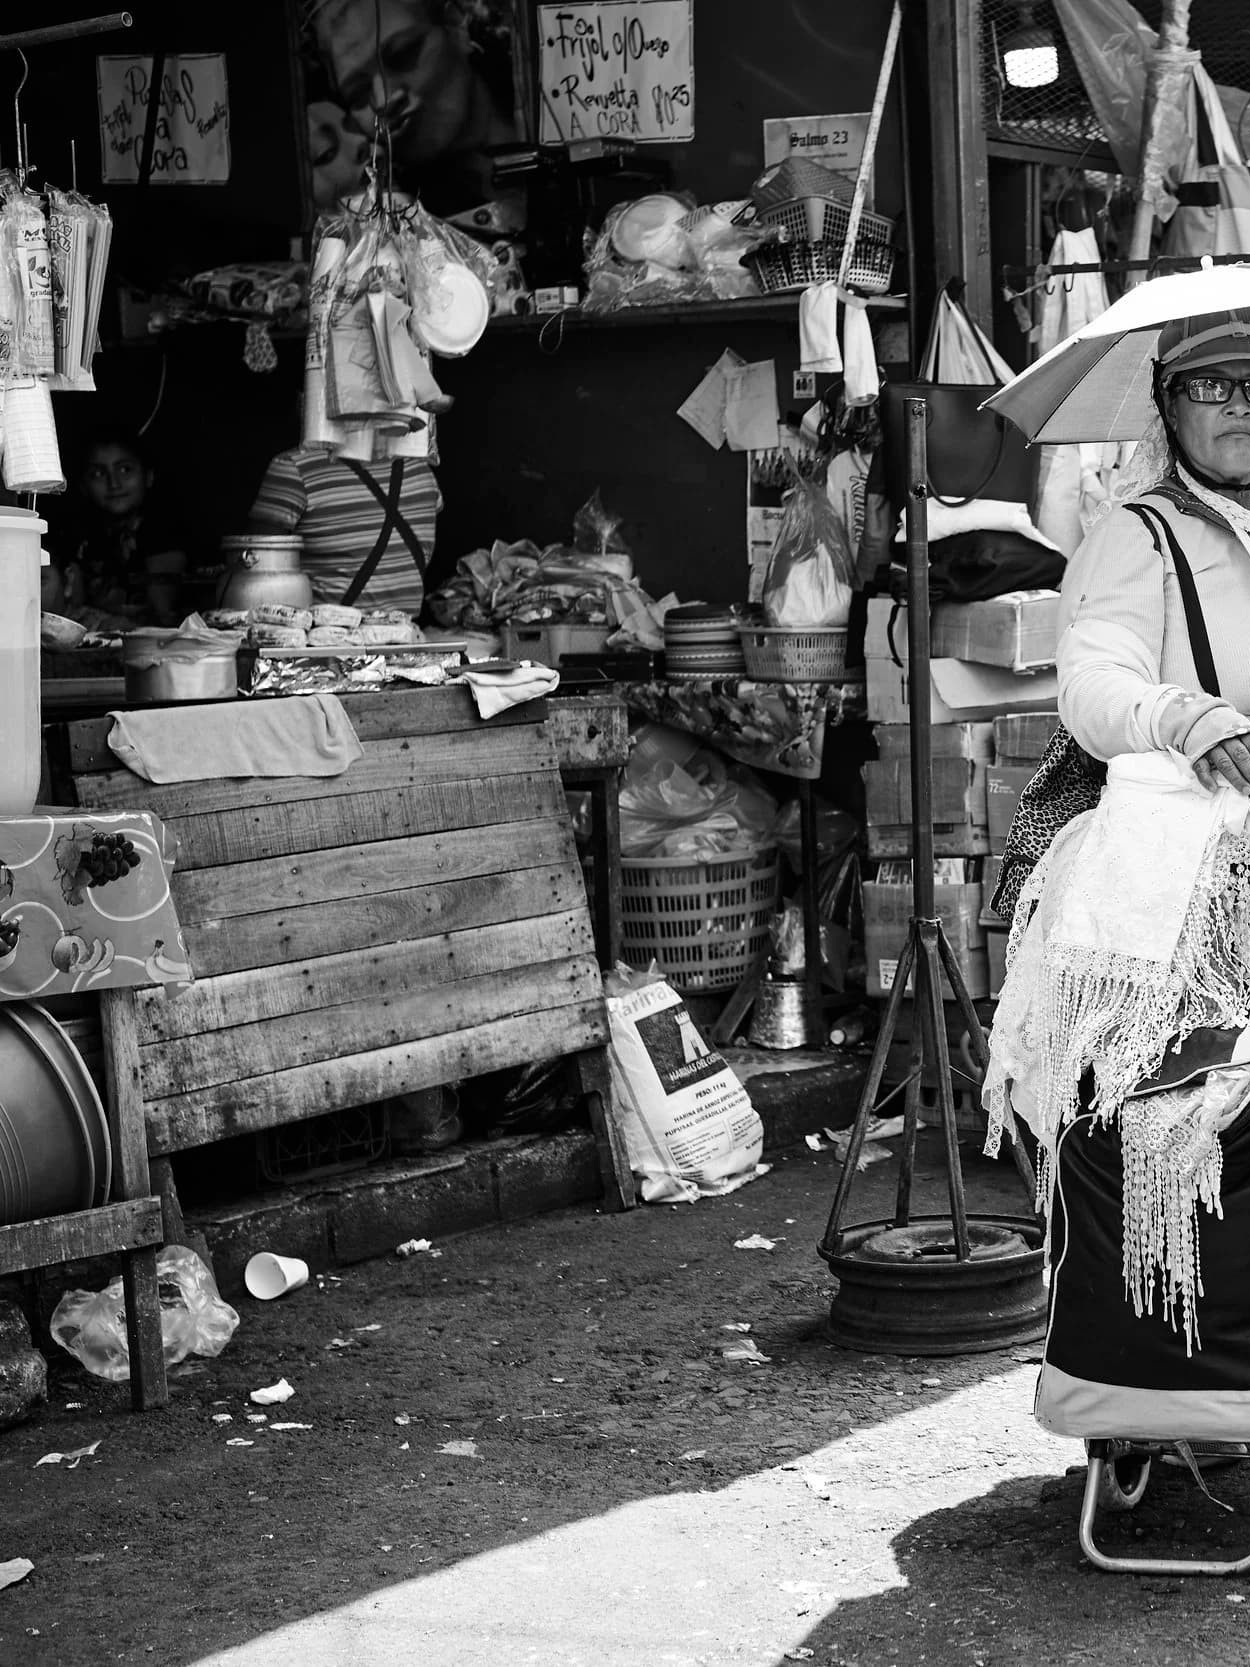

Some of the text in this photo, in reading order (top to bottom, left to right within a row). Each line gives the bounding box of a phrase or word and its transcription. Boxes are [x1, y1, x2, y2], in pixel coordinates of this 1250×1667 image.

[597, 109, 642, 136] CORA
[790, 131, 848, 147] Salmo 23
